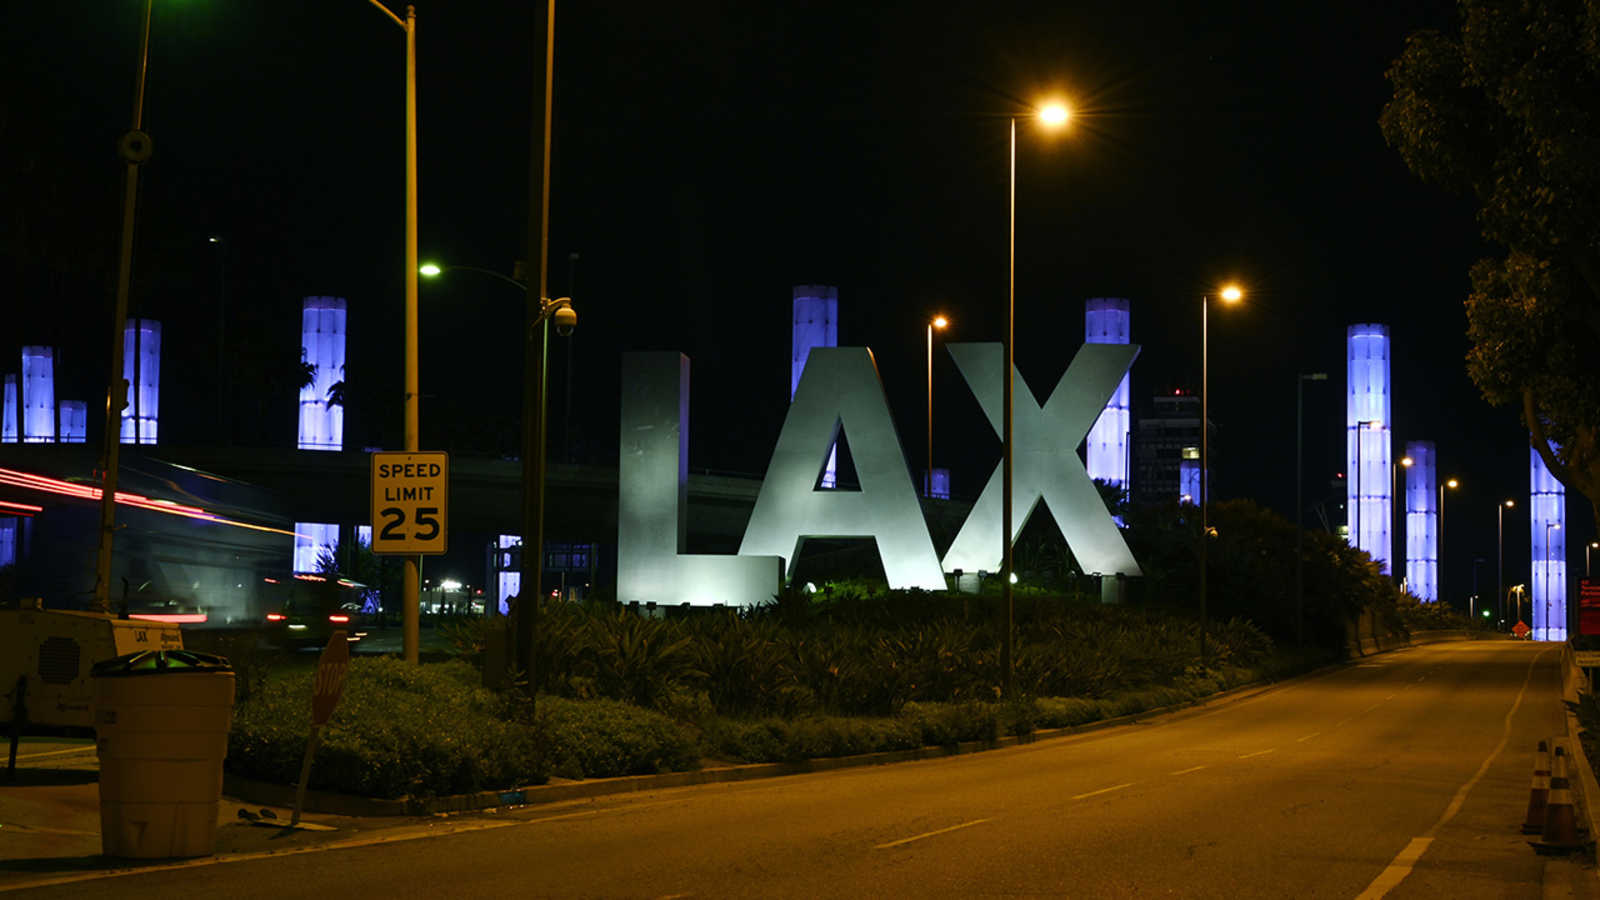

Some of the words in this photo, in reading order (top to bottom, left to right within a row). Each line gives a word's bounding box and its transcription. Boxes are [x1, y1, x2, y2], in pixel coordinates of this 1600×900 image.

[379, 464, 441, 478] SPEED
[616, 342, 1143, 606] LAX
[385, 487, 434, 501] LIMIT
[380, 507, 440, 541] 25
[134, 630, 148, 642] LAX
[313, 661, 346, 697] STOP
